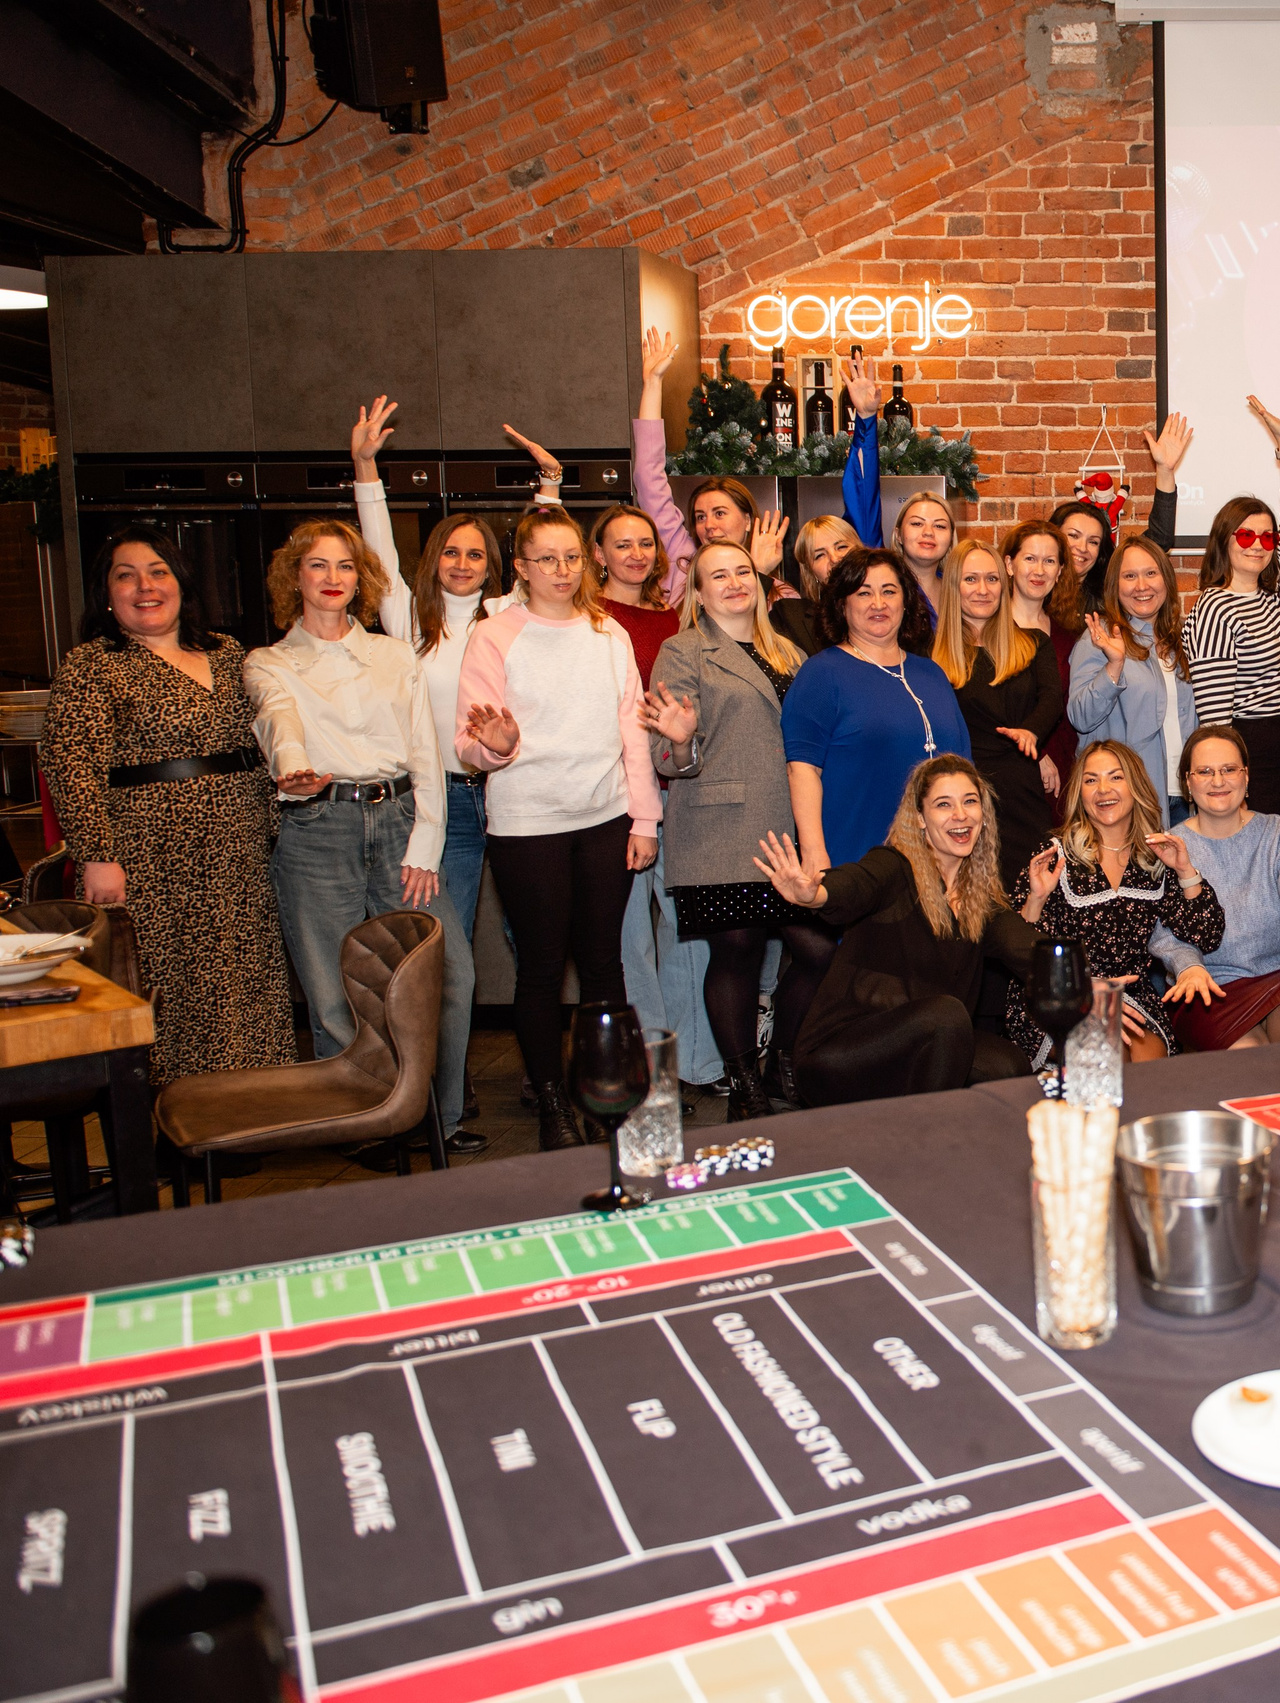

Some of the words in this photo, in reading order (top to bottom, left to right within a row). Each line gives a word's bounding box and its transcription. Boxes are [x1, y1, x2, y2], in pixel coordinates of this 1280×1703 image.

[747, 280, 973, 352] gorenje
[712, 1311, 756, 1345] OLD
[731, 1340, 820, 1431] FASHIONED
[872, 1336, 941, 1393] OTHER
[626, 1397, 678, 1439] FLIP
[490, 1427, 538, 1474] TINI
[795, 1425, 865, 1491] STYLE
[335, 1431, 397, 1538] SMOOTHIE
[187, 1487, 232, 1543] FIZZ
[856, 1493, 972, 1536] vodka
[17, 1507, 69, 1595] SPRITZ
[491, 1597, 564, 1635] gin
